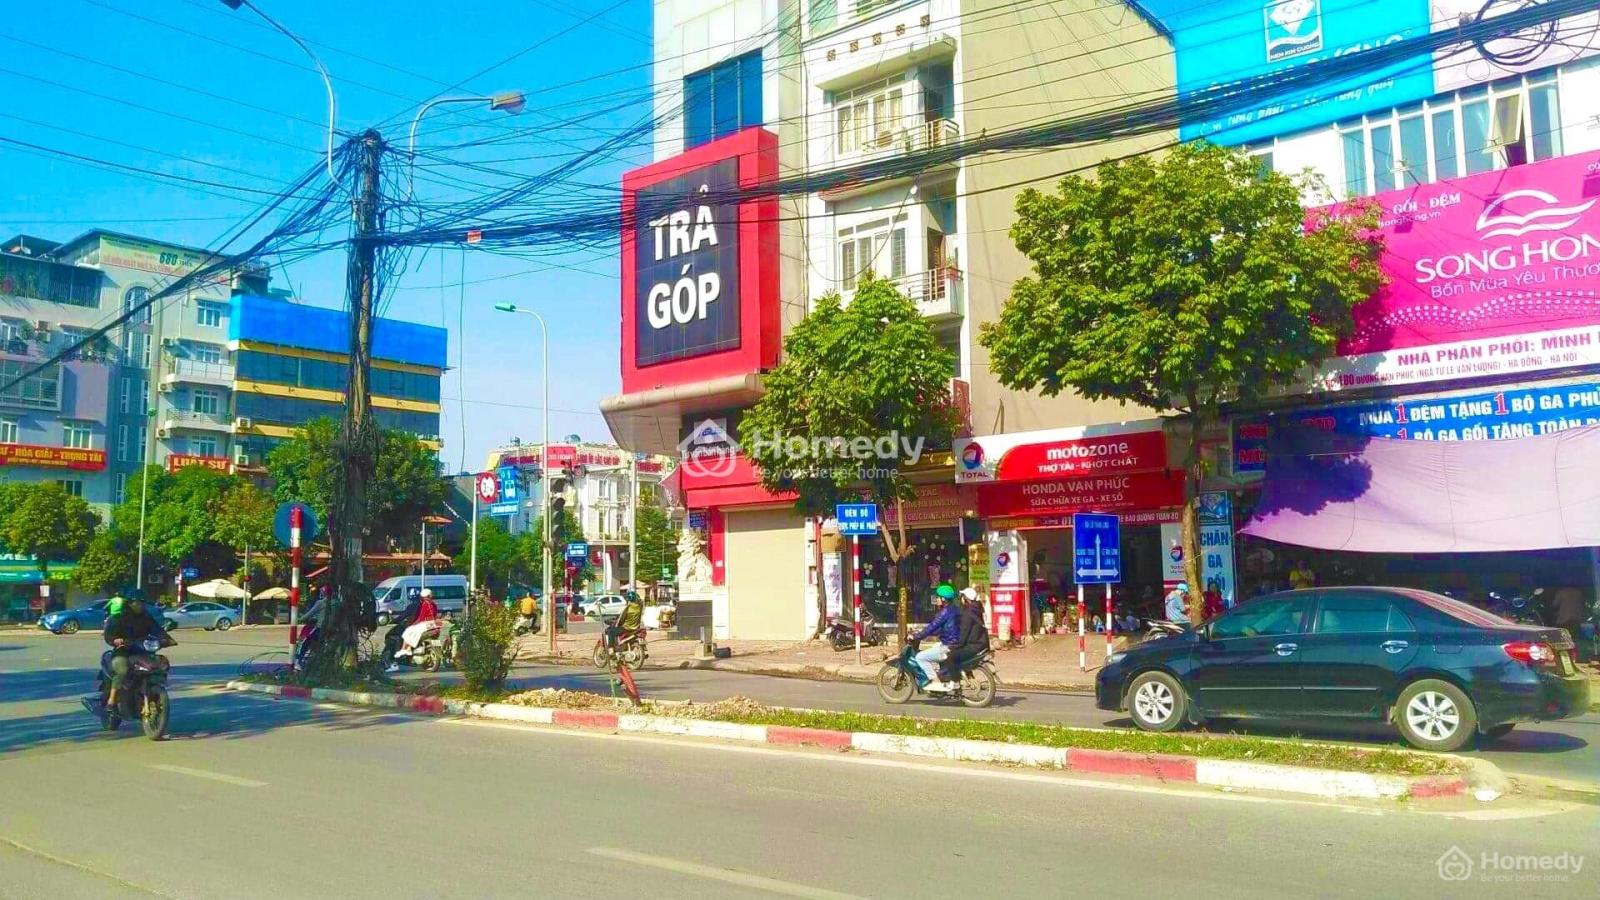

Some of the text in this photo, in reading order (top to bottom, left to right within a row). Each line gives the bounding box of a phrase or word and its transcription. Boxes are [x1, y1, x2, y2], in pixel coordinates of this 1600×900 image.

[1392, 198, 1417, 215] GỐI
[1429, 193, 1461, 209] ĐỆM
[159, 251, 178, 266] 680
[1415, 246, 1516, 284] SONG
[1431, 282, 1463, 299] Bốn
[1470, 278, 1507, 292] Mùa
[1514, 272, 1545, 286] Yêu
[647, 263, 721, 329] GÓP
[1397, 351, 1430, 366] NHÀ
[1436, 344, 1482, 361] PHÂN
[1541, 332, 1590, 350] MINH
[1339, 374, 1354, 386] 180
[1359, 410, 1393, 425] MUA
[1395, 403, 1409, 425] 1
[1410, 404, 1446, 423] ĐỆM
[1451, 397, 1491, 421] TẶNG
[1494, 392, 1509, 416] 1
[1511, 394, 1534, 414] BỘ
[1539, 394, 1564, 410] GA
[1047, 442, 1129, 460] motozone
[1111, 455, 1138, 467] CHẤT
[961, 471, 988, 479] TOTAL
[1022, 476, 1130, 495] HONDA VẠN PHÚC
[1071, 496, 1081, 504] XE
[1083, 495, 1095, 504] GA
[1100, 494, 1110, 502] XE
[1208, 554, 1222, 569] GA
